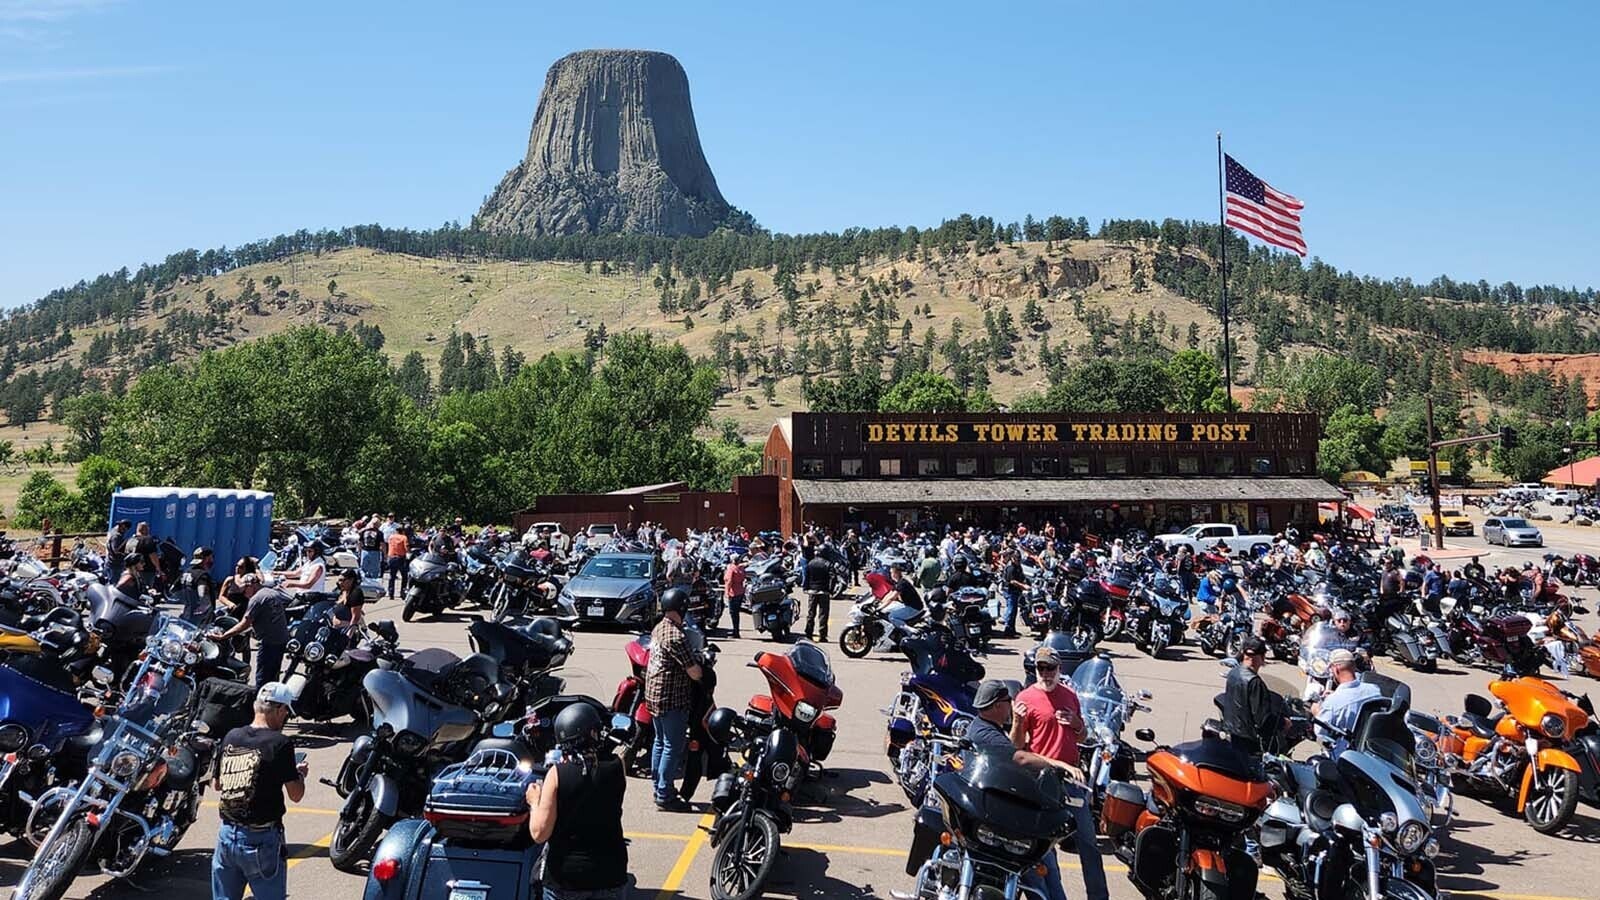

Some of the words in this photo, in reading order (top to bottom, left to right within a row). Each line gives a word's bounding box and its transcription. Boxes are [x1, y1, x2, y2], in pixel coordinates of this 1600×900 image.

[869, 423, 959, 442] DEVILS
[973, 423, 1057, 442] TOWER
[1071, 423, 1178, 442] TRADING
[1192, 423, 1250, 442] POST
